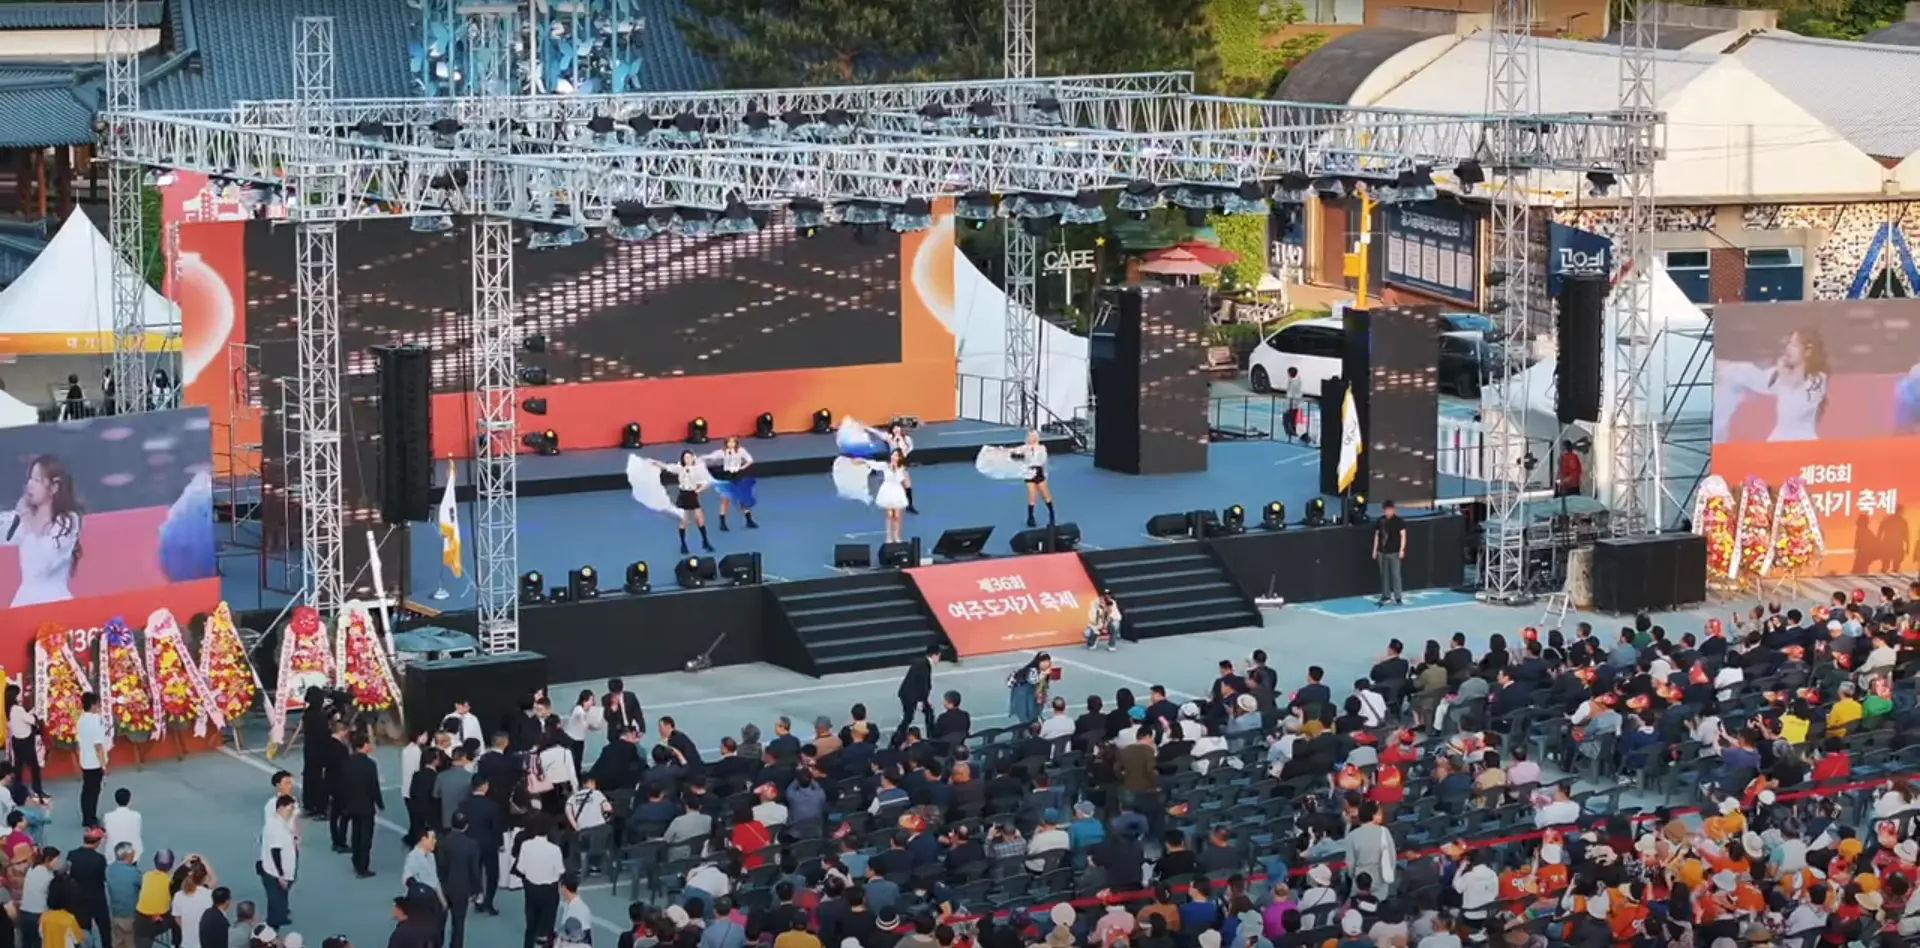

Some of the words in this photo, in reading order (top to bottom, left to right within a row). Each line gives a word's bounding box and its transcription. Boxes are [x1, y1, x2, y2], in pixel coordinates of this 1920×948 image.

[1043, 250, 1095, 269] CAFE
[1800, 463, 1852, 485] 제36회
[1811, 490, 1852, 517] 자기
[1856, 488, 1897, 515] 축제
[976, 574, 1026, 593] 제36회
[948, 594, 1040, 620] 여주도자기
[1039, 590, 1079, 612] 축제
[67, 626, 103, 652] 36
